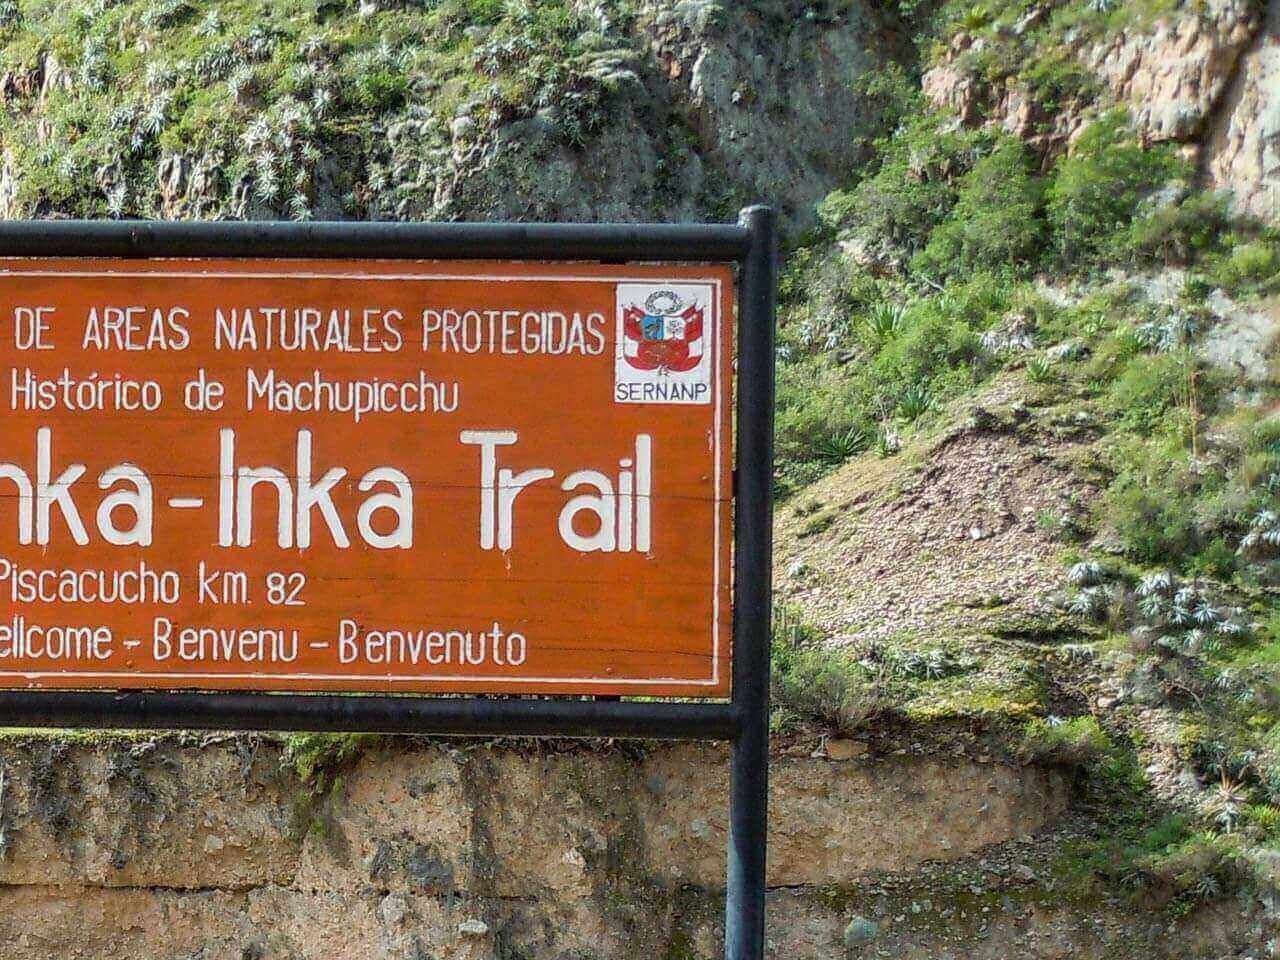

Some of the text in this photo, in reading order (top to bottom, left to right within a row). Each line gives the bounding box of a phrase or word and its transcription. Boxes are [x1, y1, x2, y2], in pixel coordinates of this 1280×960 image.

[14, 306, 56, 350] DE
[81, 306, 190, 351] AREAS
[214, 307, 404, 353] NATURALES
[422, 308, 606, 355] PROTEGIDAS
[11, 367, 162, 411] Histórico
[184, 368, 225, 411] de
[246, 367, 459, 423] Machupicchu
[616, 382, 708, 401] SERNANP
[460, 429, 652, 554] Trail
[266, 571, 306, 606] 82
[153, 617, 298, 662] Benvenu
[338, 619, 527, 666] Benvenuto
